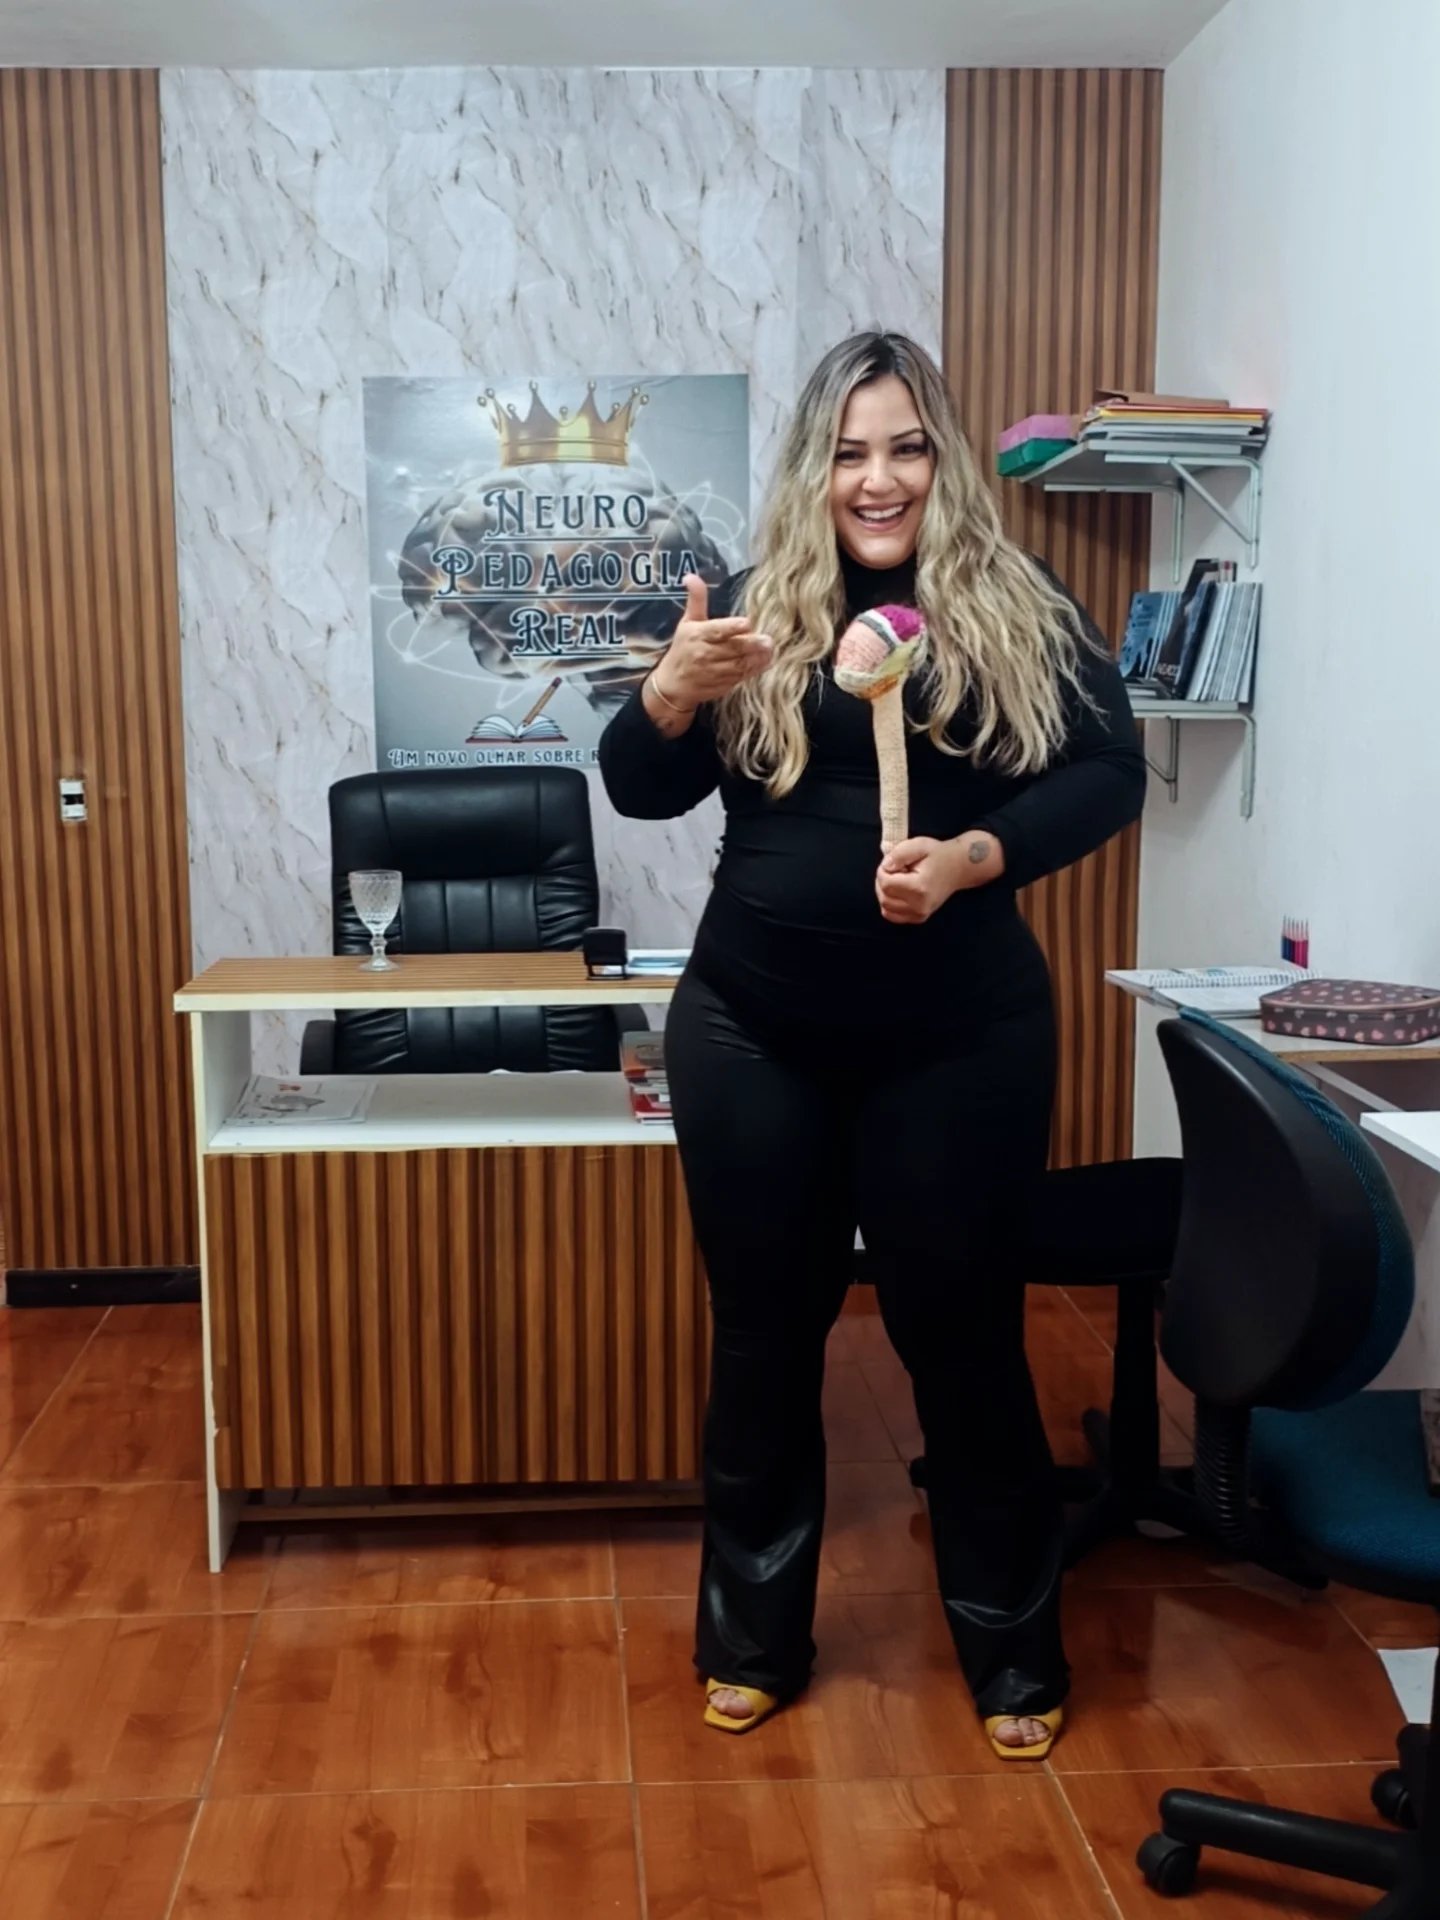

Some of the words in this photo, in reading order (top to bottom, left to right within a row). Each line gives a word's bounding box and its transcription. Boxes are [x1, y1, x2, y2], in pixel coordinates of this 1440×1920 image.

[483, 489, 647, 537] NEURO
[432, 546, 699, 595] PEDAGOGIA
[511, 608, 624, 655] REAL
[426, 750, 468, 764] NOVO
[476, 750, 526, 764] OLHAR
[534, 750, 584, 763] SOBRE
